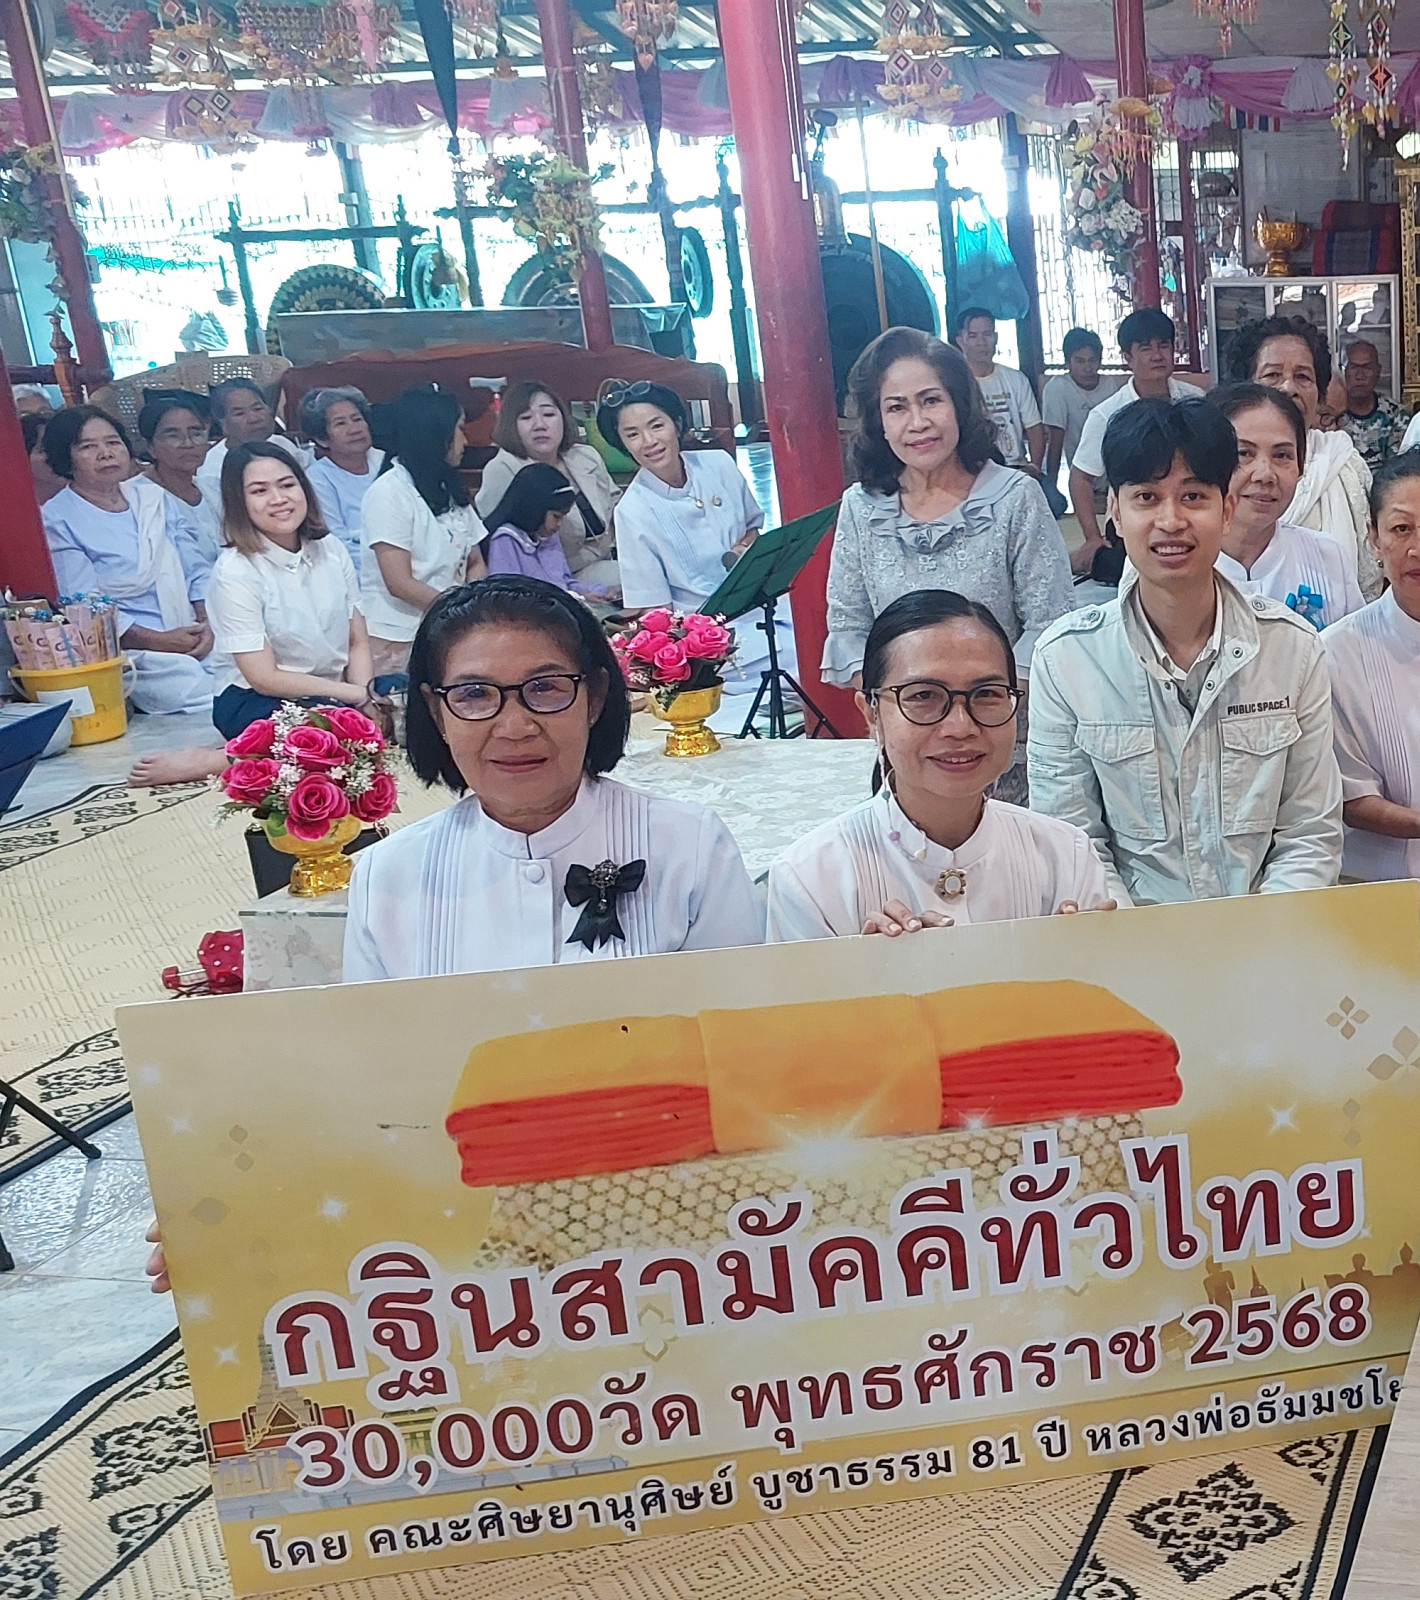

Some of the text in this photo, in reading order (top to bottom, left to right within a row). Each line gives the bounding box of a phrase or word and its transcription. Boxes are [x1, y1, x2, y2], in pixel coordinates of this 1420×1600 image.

[1227, 703, 1256, 715] PUBLIC
[276, 1139, 1355, 1401] กฐินสามัคคีทั่วไทย
[731, 1329, 1157, 1448] พุทธศักราช
[1188, 1287, 1369, 1366] 2568
[256, 1528, 349, 1570] โดย
[371, 1465, 734, 1554] คณะศิษยานุศิษย์
[753, 1448, 952, 1510] บูชาธรรม
[972, 1436, 1021, 1469] 81
[1038, 1420, 1068, 1458] ปี
